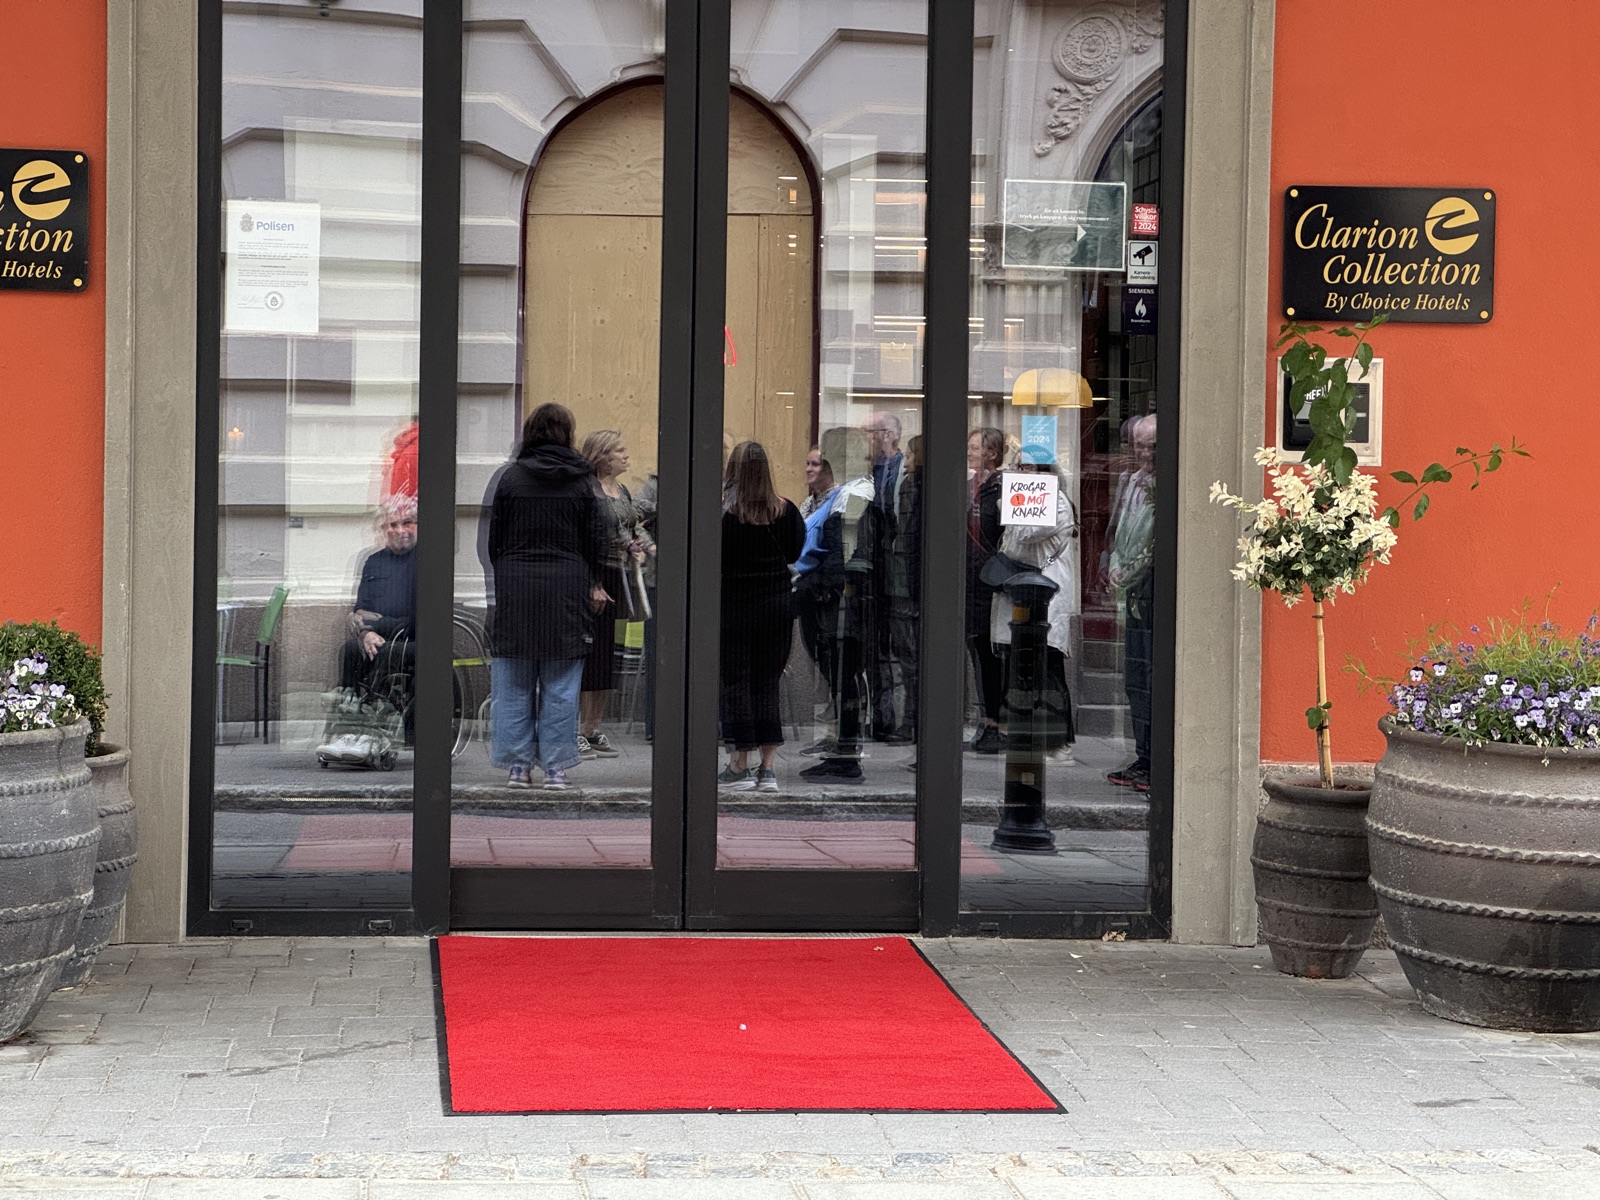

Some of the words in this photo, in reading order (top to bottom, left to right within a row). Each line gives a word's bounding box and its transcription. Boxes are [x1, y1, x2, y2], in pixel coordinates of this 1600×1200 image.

[256, 221, 294, 231] Polisen
[1138, 222, 1156, 230] 2024
[1294, 203, 1418, 250] Clarion
[1, 260, 63, 279] Hotels
[1323, 252, 1481, 285] Collection
[1324, 292, 1348, 313] By
[1350, 292, 1411, 310] Choice
[1414, 293, 1470, 311] Hotels
[1027, 435, 1051, 443] 2024
[1010, 481, 1046, 494] KROGAR
[1027, 492, 1051, 507] MOT
[1012, 506, 1047, 519] KNARK
